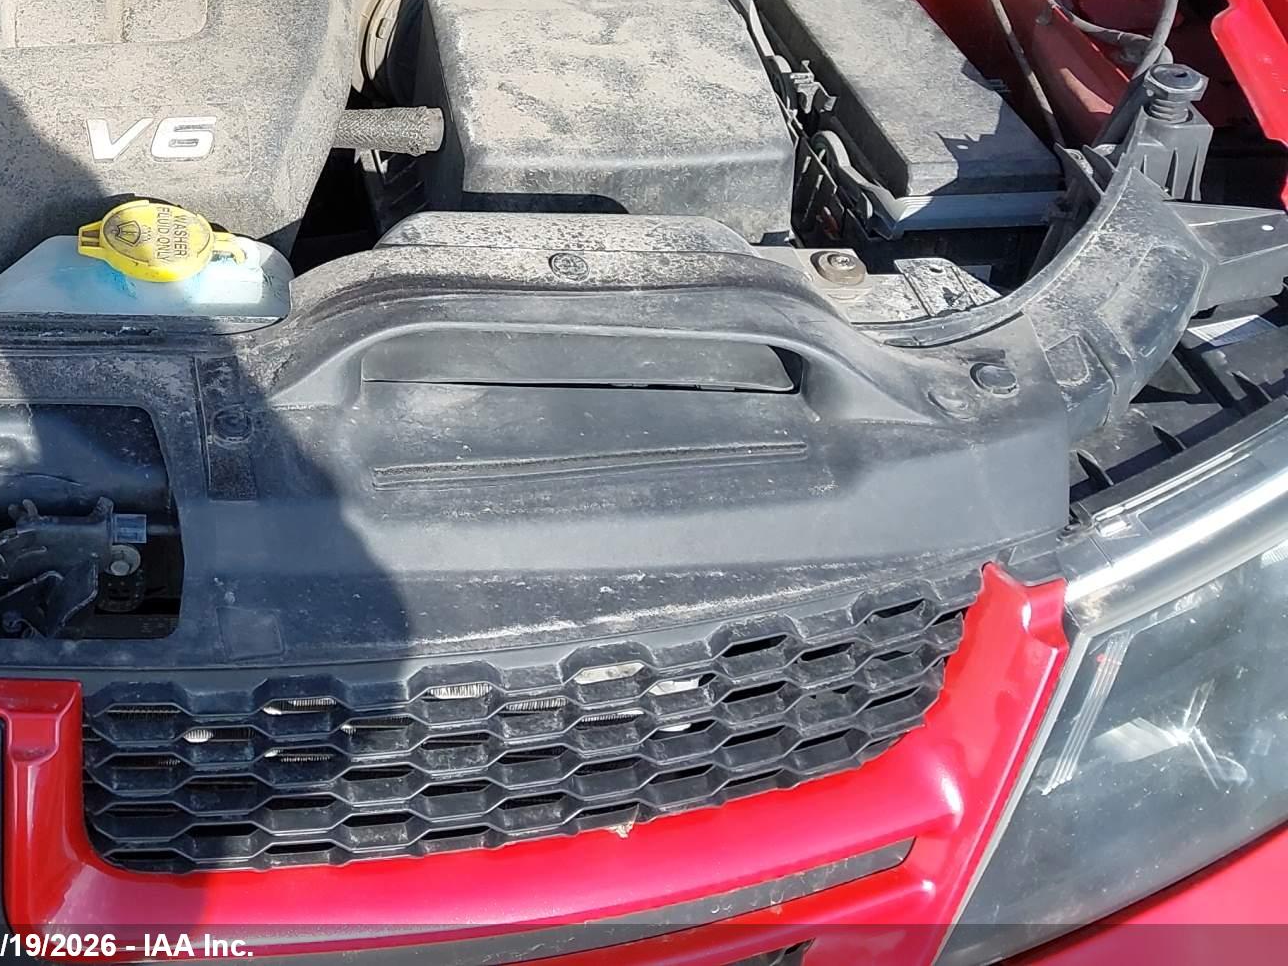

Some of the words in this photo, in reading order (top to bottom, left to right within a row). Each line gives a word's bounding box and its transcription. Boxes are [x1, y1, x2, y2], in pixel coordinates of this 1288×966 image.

[85, 116, 216, 162] V6
[156, 206, 170, 234] FLUID
[173, 214, 188, 257] WASHER
[156, 236, 172, 264] ONLY
